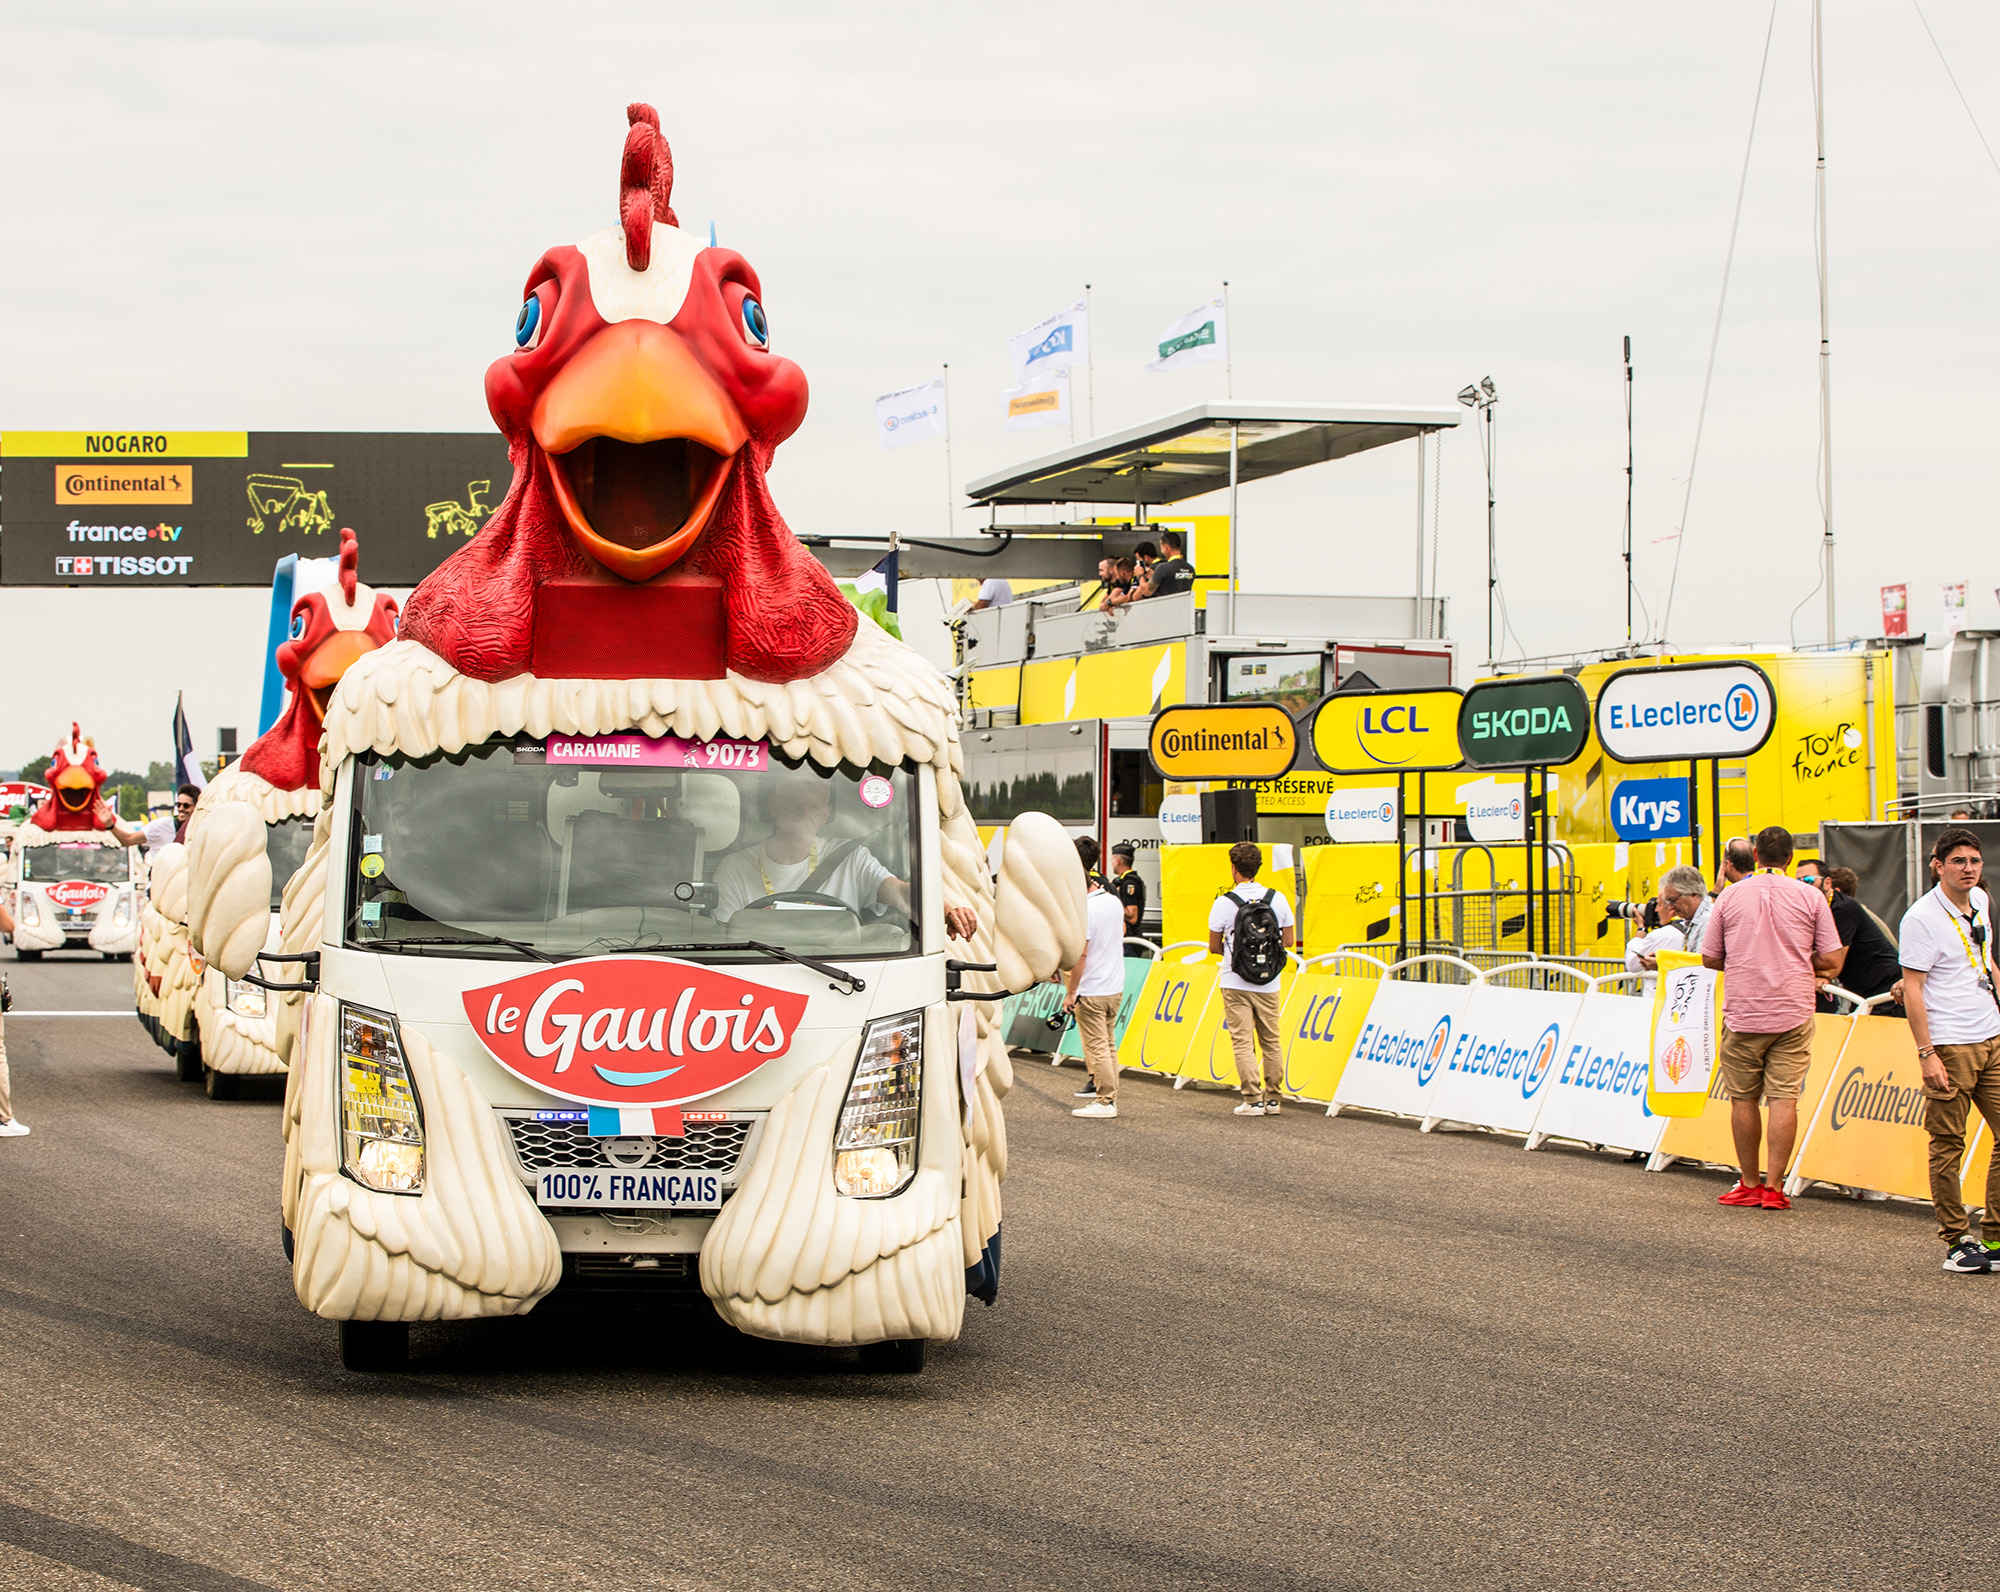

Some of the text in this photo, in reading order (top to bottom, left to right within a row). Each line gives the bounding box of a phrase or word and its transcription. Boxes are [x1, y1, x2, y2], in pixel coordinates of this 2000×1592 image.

[86, 435, 168, 453] NOGARO
[65, 474, 165, 496] Continental
[94, 556, 193, 575] TISSOT
[1363, 706, 1430, 735] LCL
[1610, 701, 1722, 730] E.Leclerc
[552, 742, 641, 759] CARAVANE
[705, 743, 760, 768] 9073
[1161, 727, 1269, 759] Continental
[1274, 777, 1334, 794] RÉSERVÉ
[1162, 812, 1201, 823] E.Lecler
[1329, 808, 1378, 820] E.Leclerc
[1469, 806, 1508, 818] E.Leclerc
[1619, 795, 1681, 831] Krys
[55, 884, 106, 903] Gaulois
[1154, 979, 1190, 1024] LCL
[485, 978, 785, 1074] le Gaulois
[1299, 994, 1342, 1042] LCL
[1355, 1023, 1425, 1073] E.Leclerc
[1449, 1033, 1529, 1081] E.Leclerc
[542, 1173, 718, 1207] 100% FRANÇAIS
